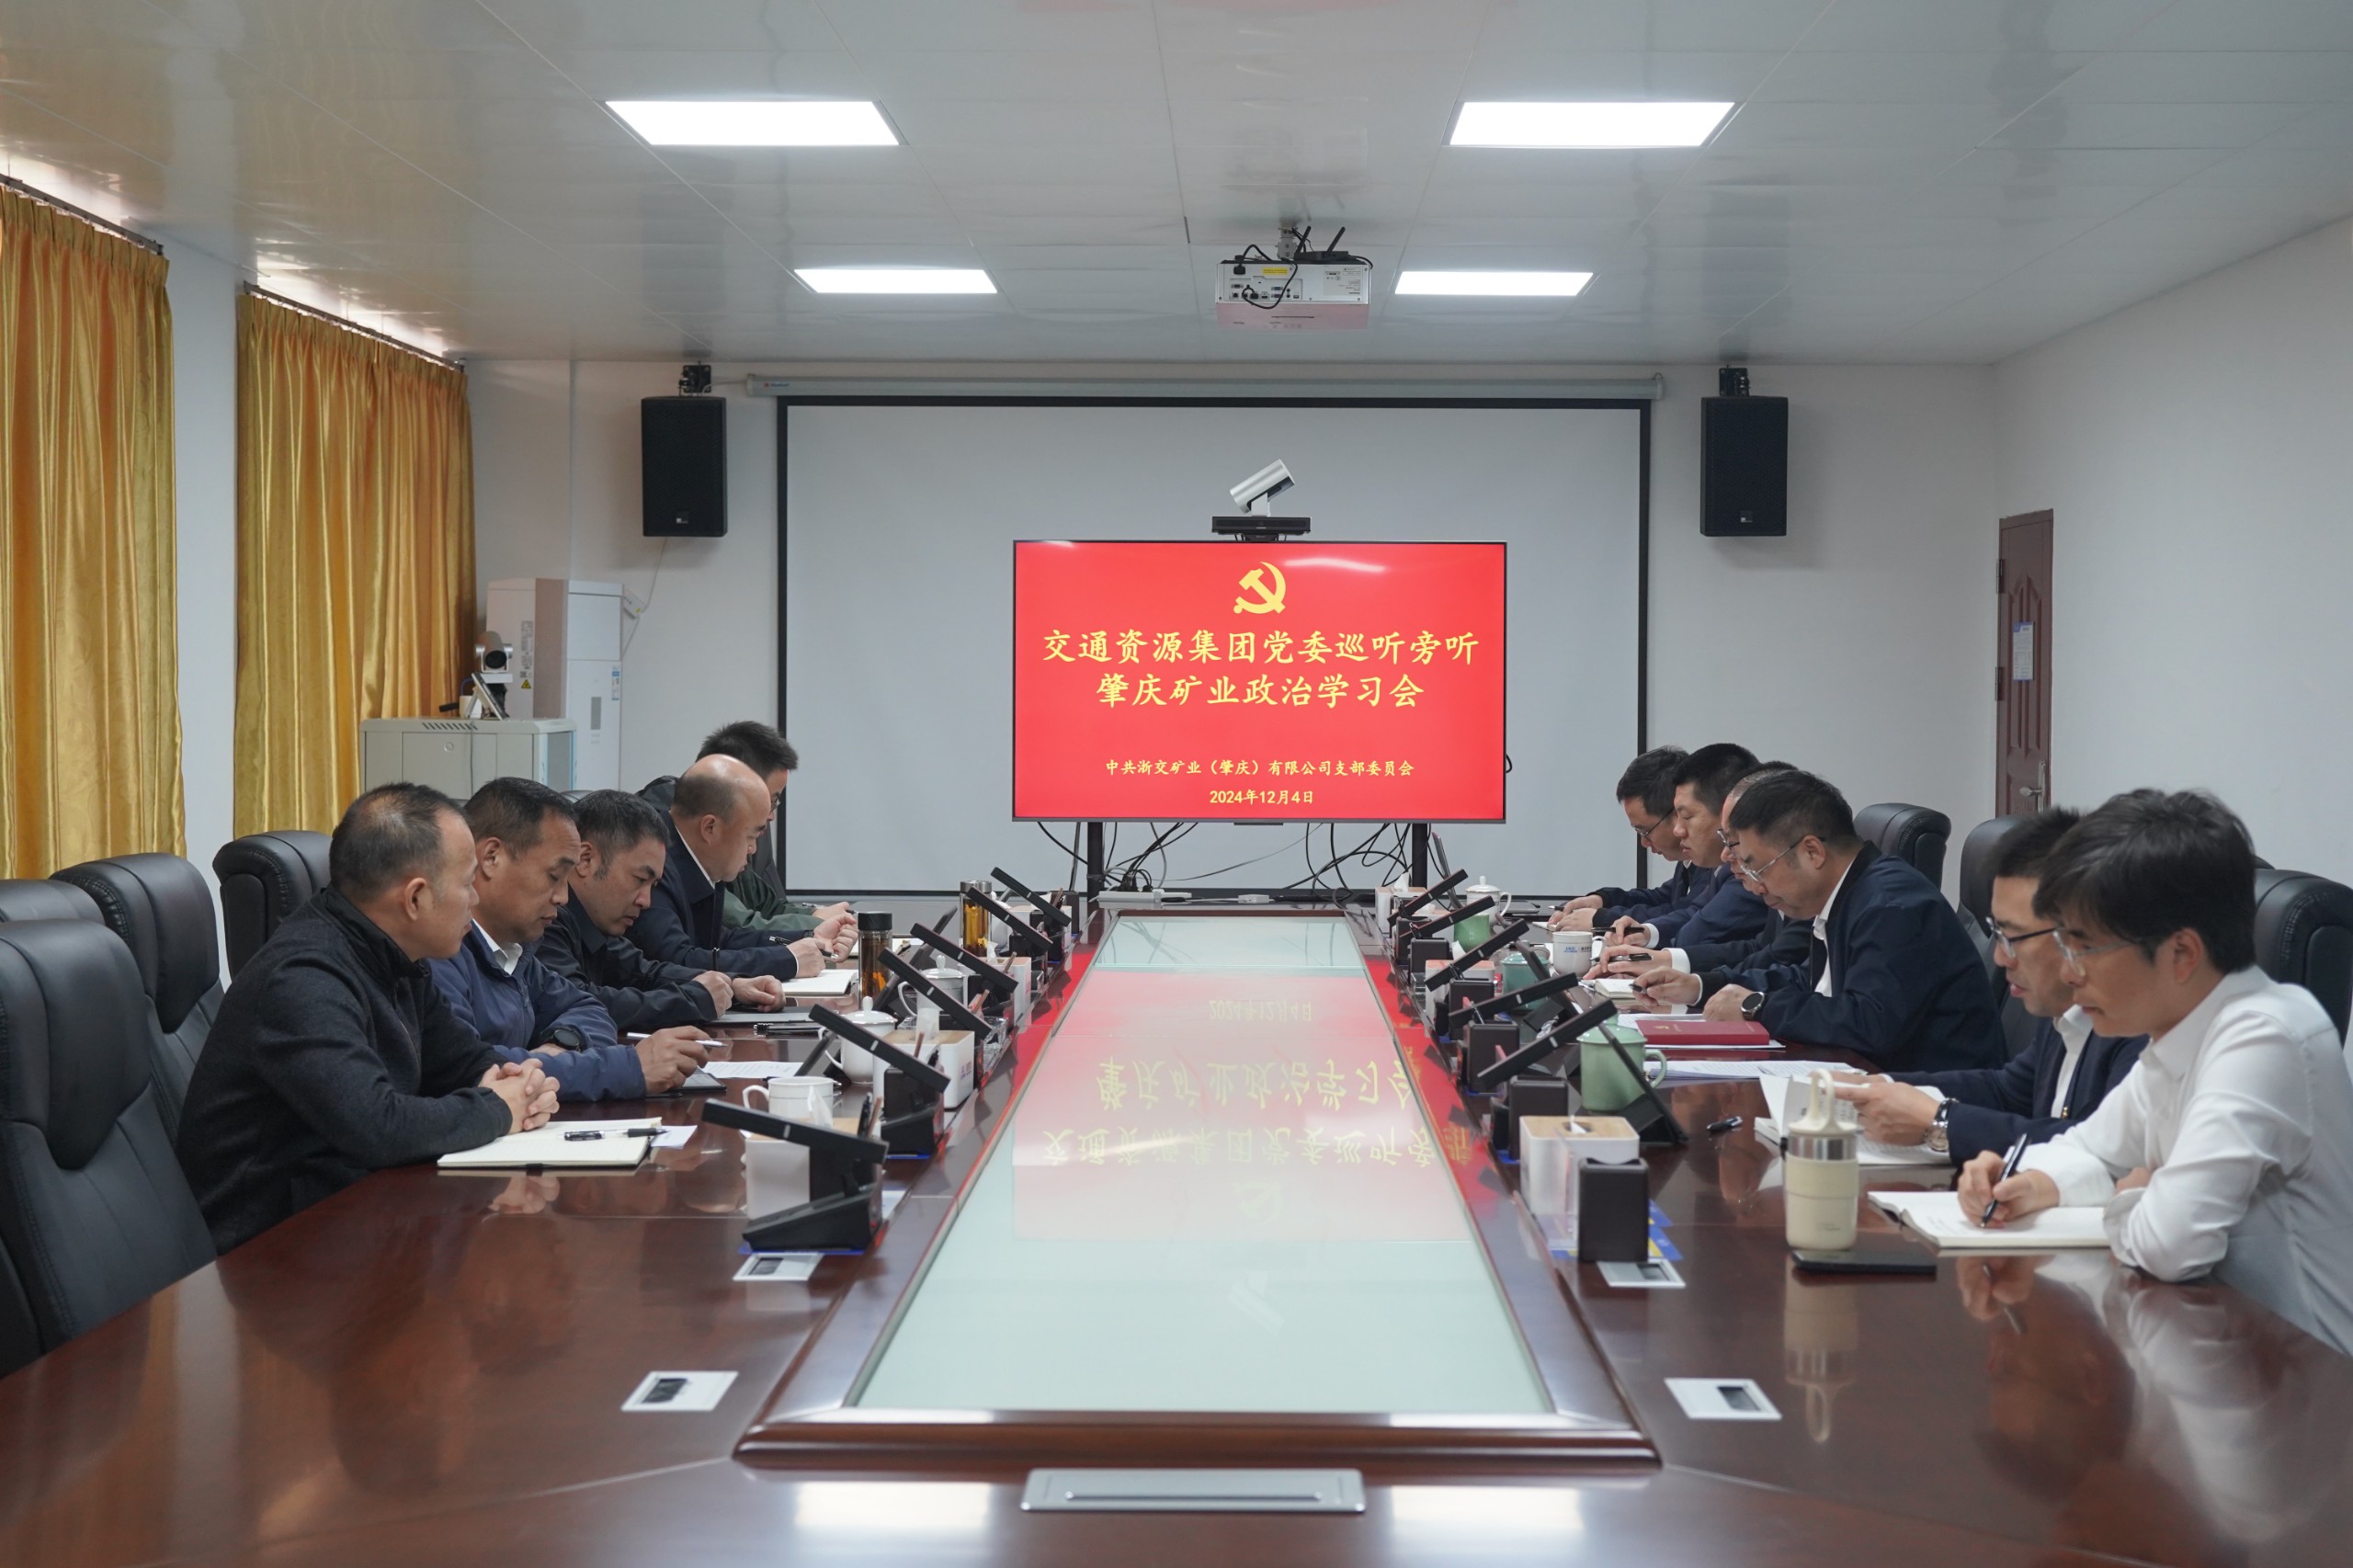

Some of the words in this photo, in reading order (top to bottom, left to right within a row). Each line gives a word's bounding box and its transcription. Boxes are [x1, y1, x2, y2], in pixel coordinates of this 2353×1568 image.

[1042, 629, 1479, 665] 交通资源集团党委巡听旁听
[1096, 673, 1425, 709] 肇庆矿业政治学习会
[1105, 759, 1415, 778] 中共浙交矿业（肇庆）有限公司支部委员会
[1209, 789, 1314, 805] 2024年12月4日
